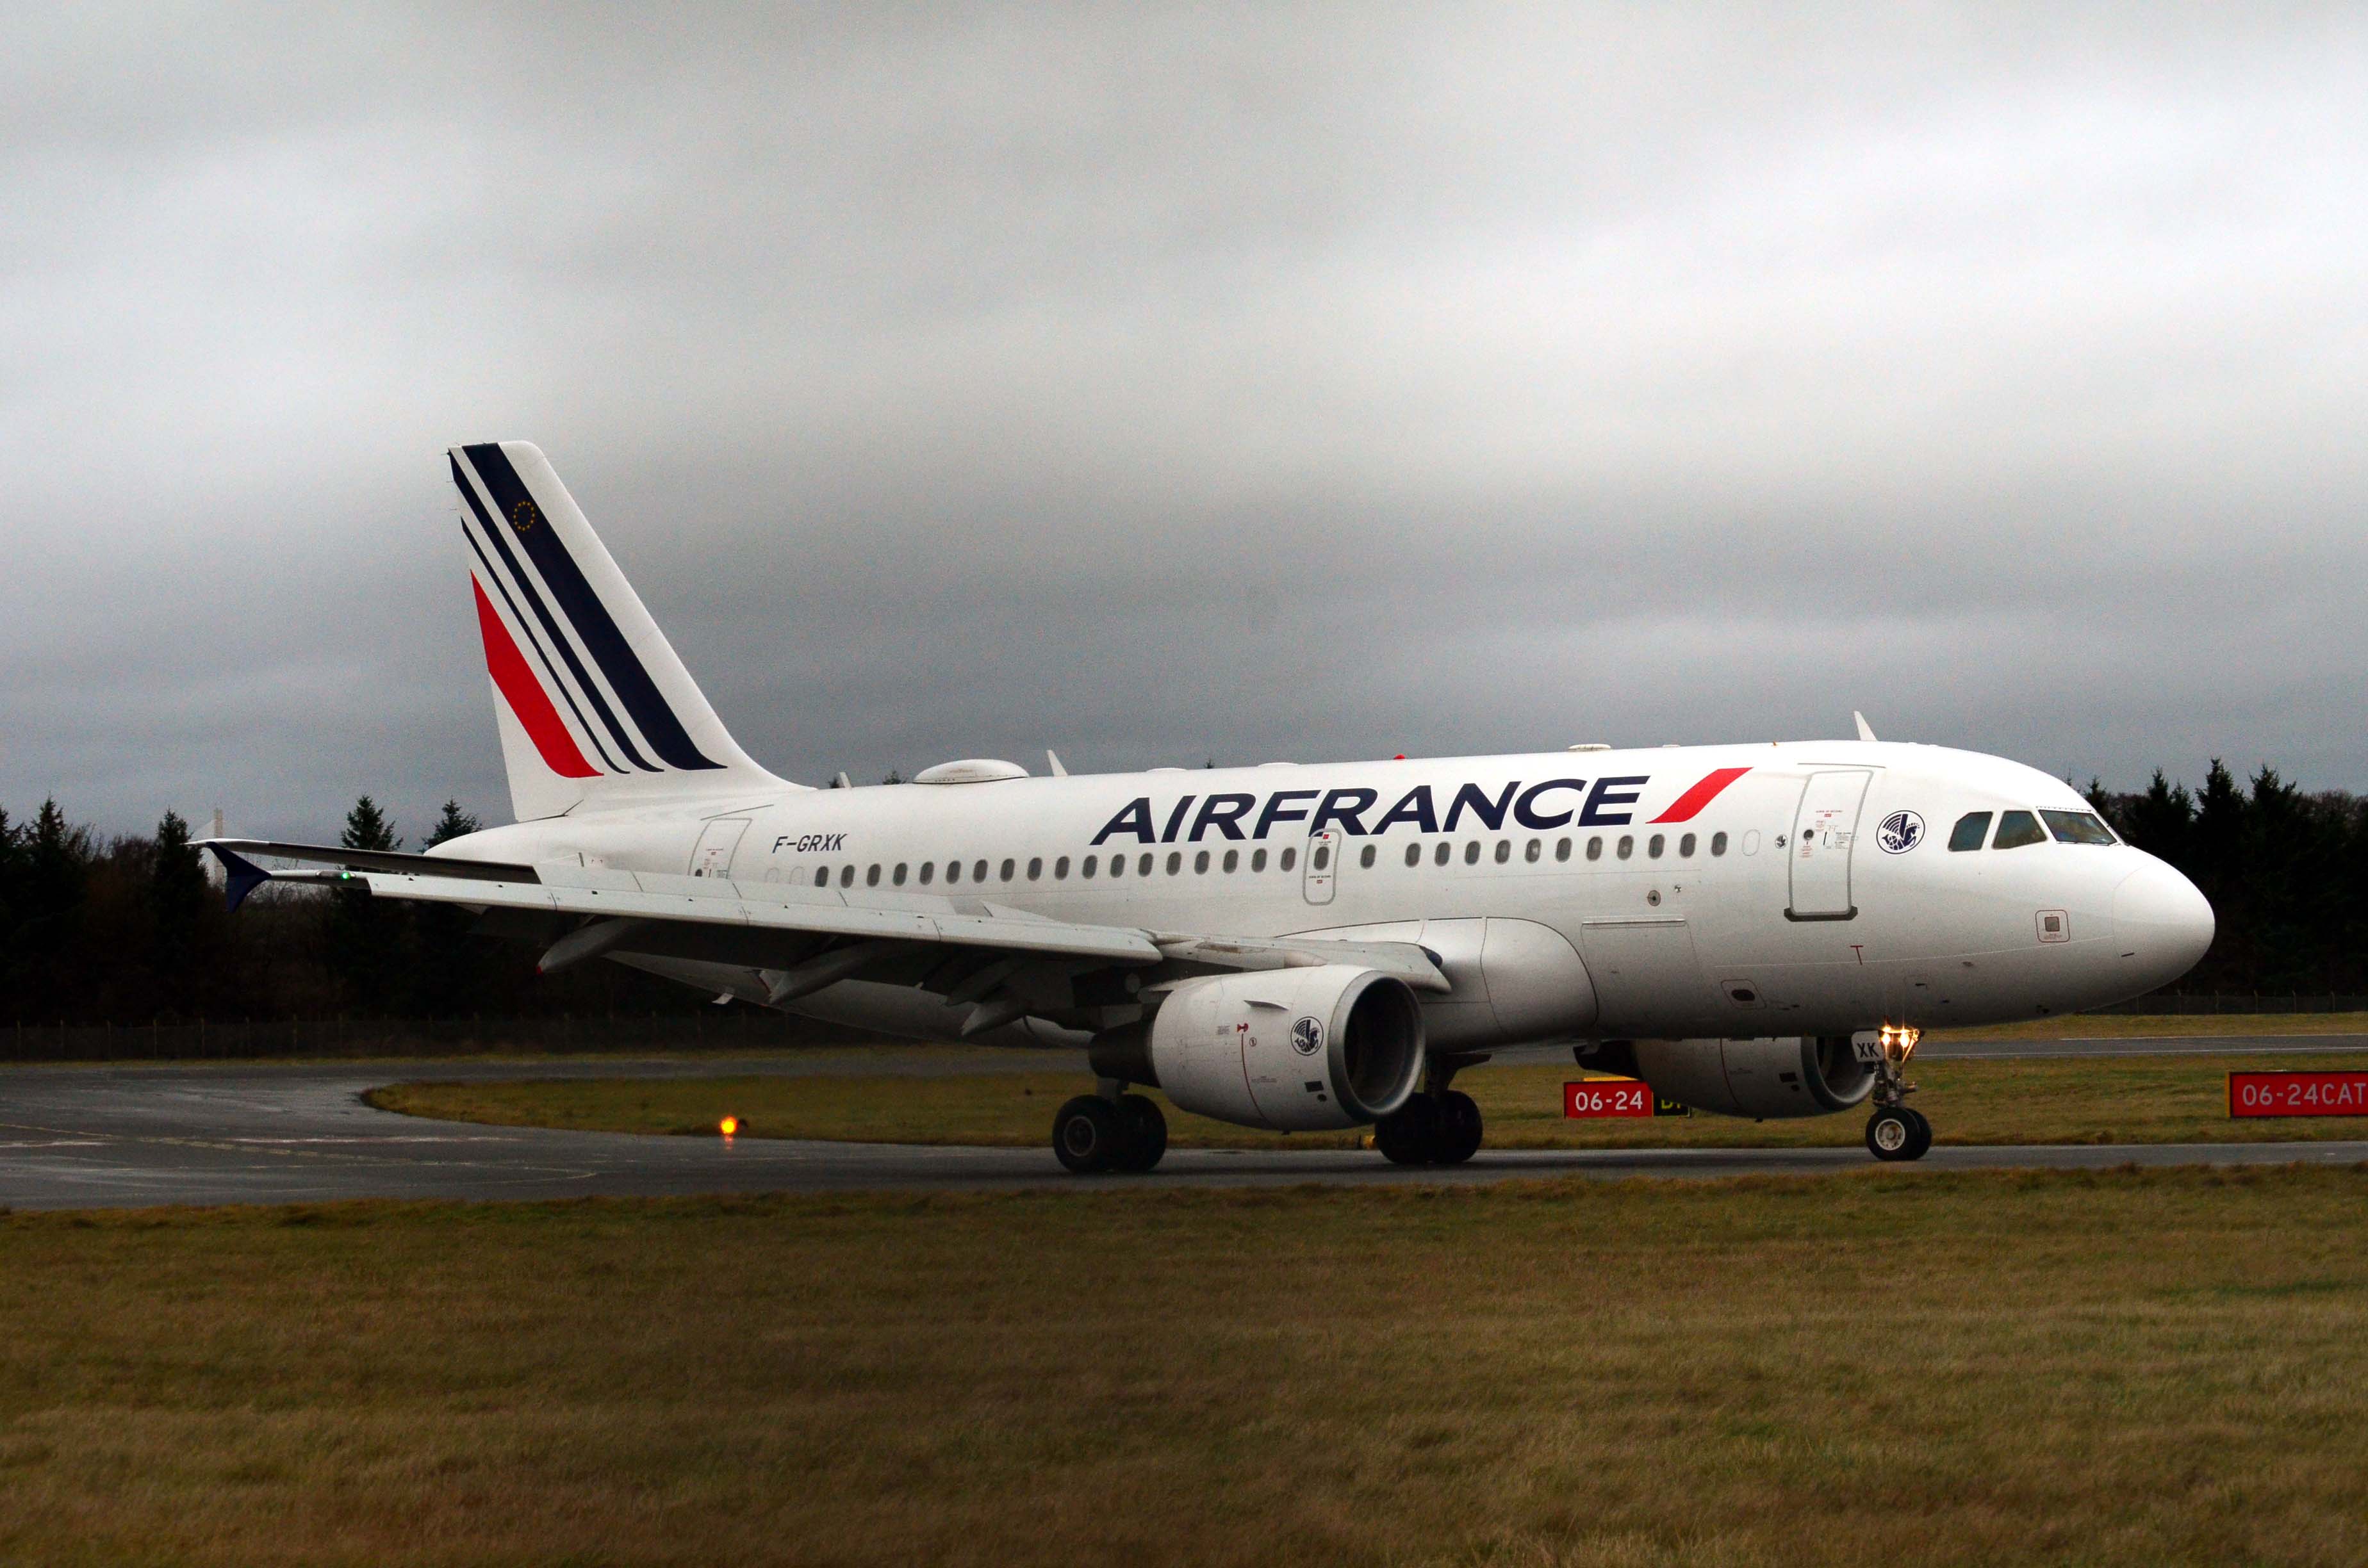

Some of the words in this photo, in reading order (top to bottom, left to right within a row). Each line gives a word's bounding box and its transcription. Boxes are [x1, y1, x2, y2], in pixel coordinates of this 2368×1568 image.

[772, 833, 848, 854] F-GRXK
[1857, 1042, 1879, 1058] XK
[1575, 1090, 1643, 1111] 06-24
